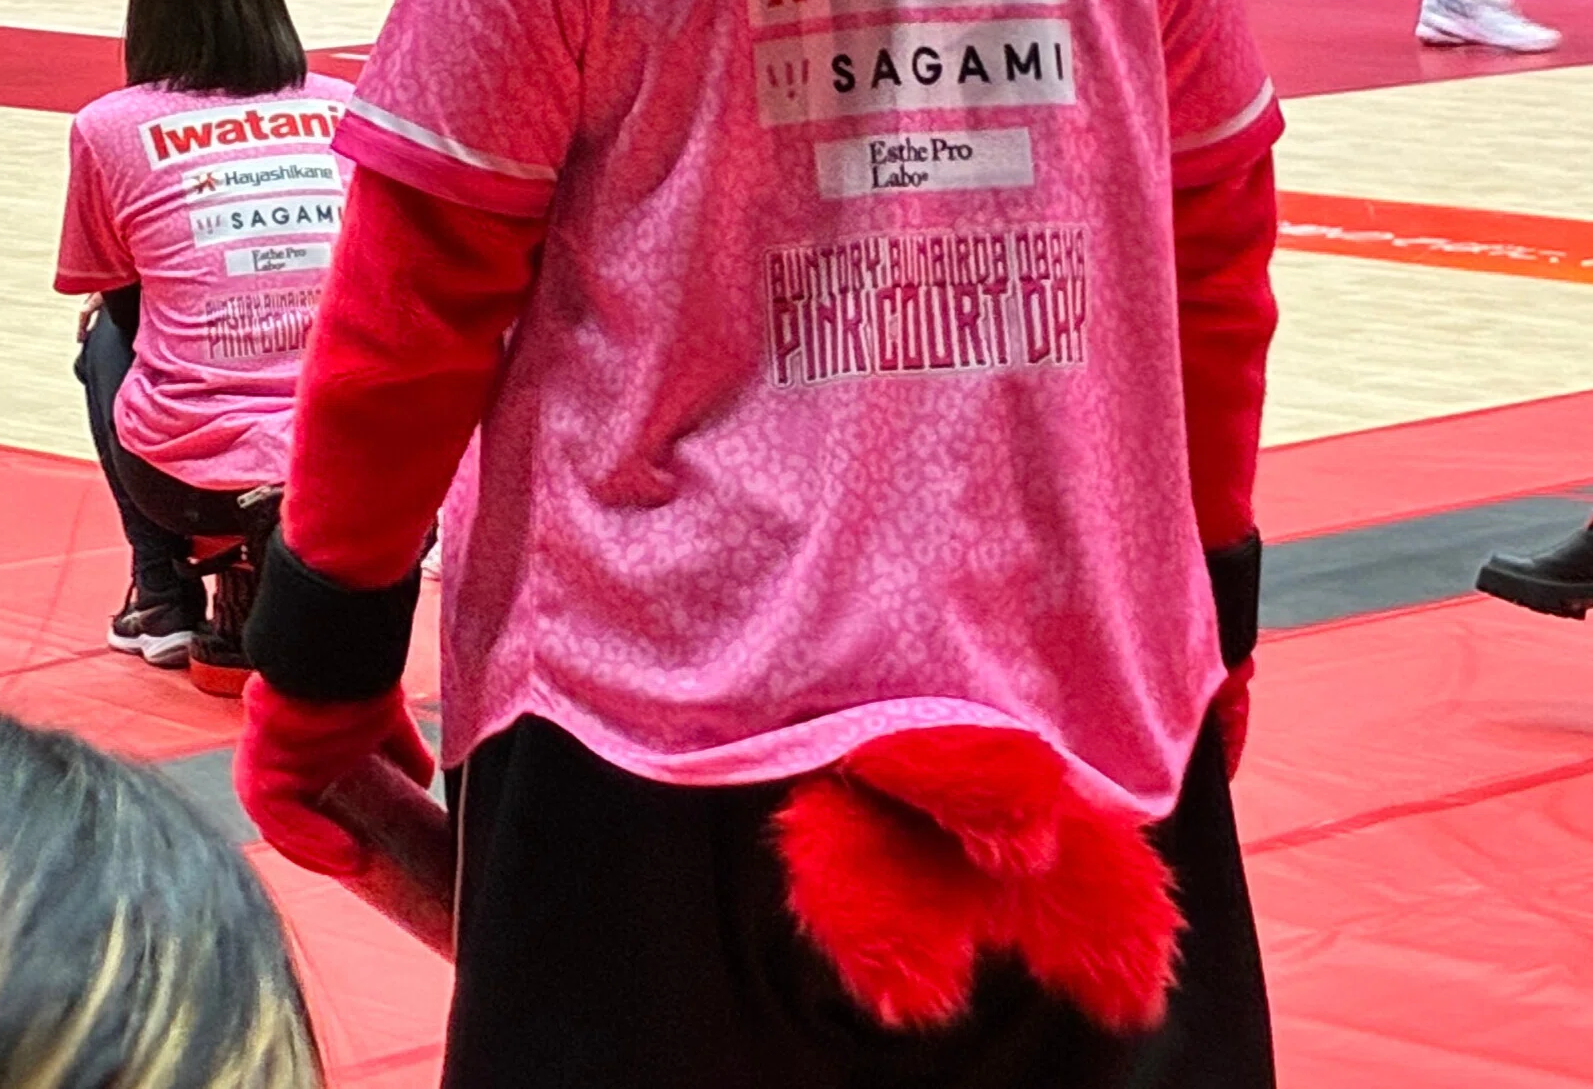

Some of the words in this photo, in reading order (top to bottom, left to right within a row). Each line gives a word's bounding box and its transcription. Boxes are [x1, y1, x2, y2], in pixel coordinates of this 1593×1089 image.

[830, 42, 1064, 94] SAGAMI
[869, 137, 929, 165] Esthe
[931, 138, 973, 161] Pro
[224, 164, 334, 187] Hayashikane
[771, 291, 870, 385] PINK
[874, 282, 1009, 372] COURT
[1020, 277, 1085, 365] DAY
